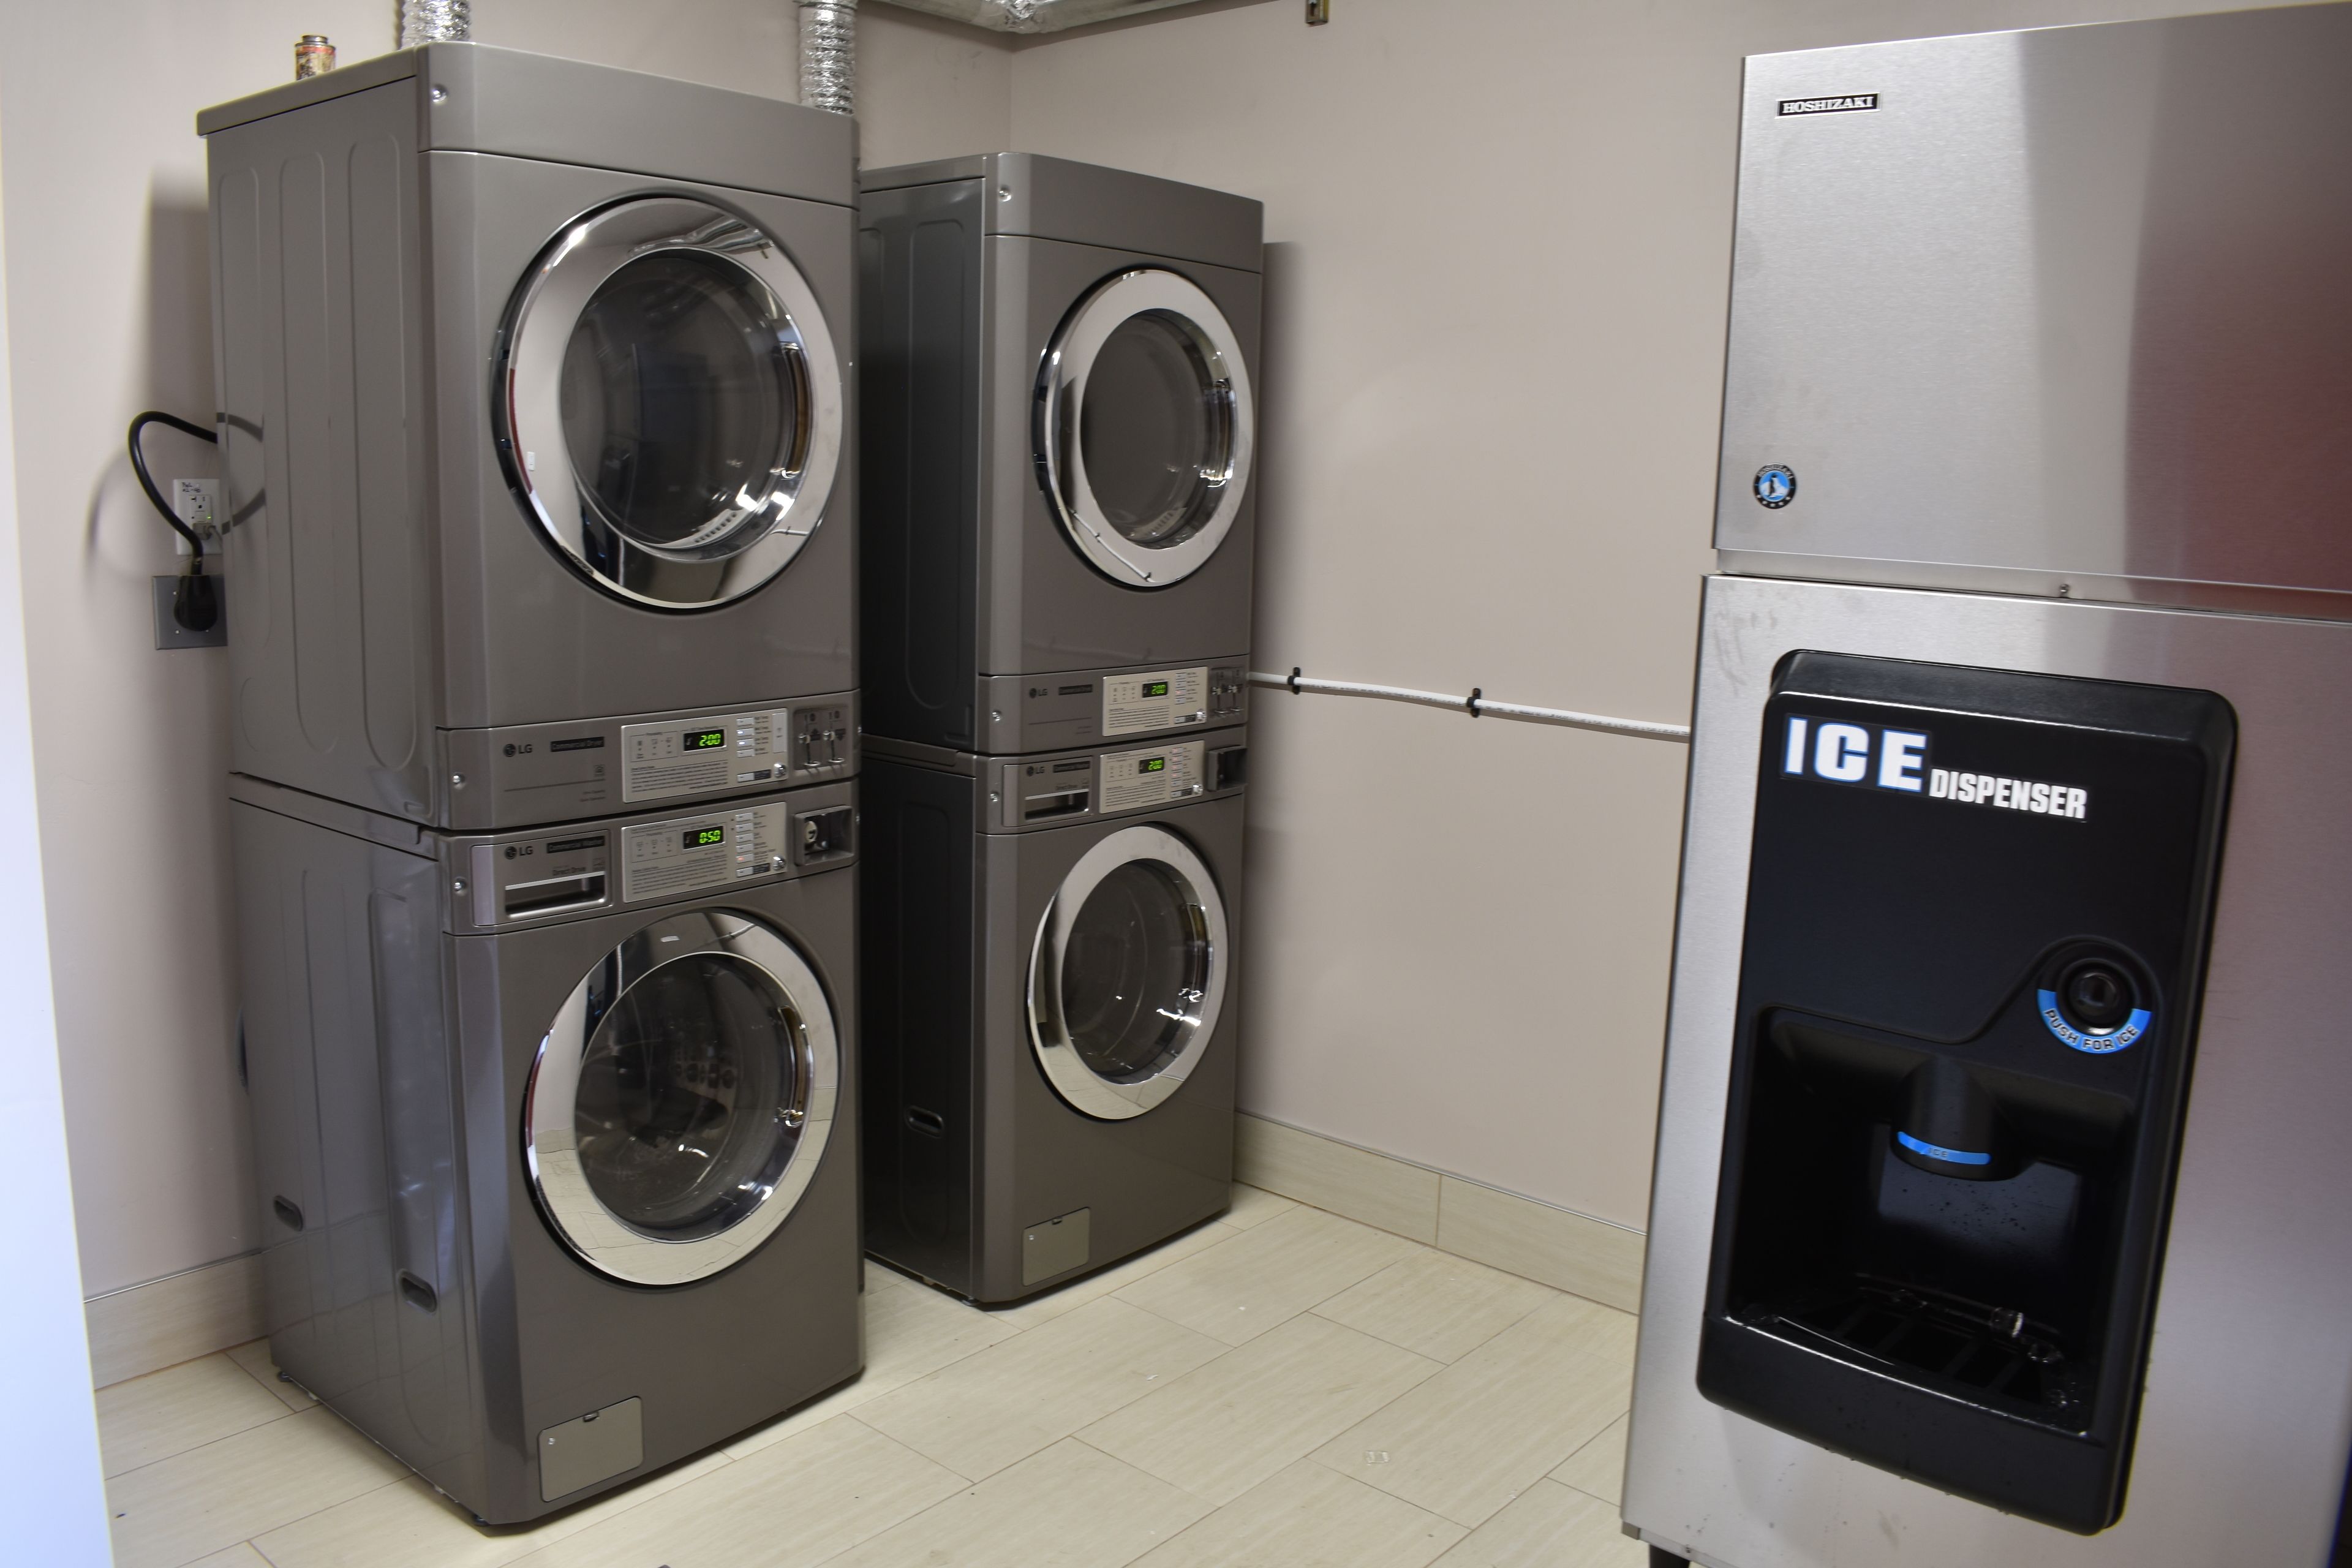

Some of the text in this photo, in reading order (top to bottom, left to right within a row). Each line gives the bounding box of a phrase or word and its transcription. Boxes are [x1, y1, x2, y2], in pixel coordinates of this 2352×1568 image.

[1782, 96, 1874, 113] HOSHIZAKI
[1784, 716, 2087, 820] ICE DISPENSER
[2044, 1008, 2141, 1050] PUSH FOR ICE
[1929, 1147, 1949, 1158] ICE
